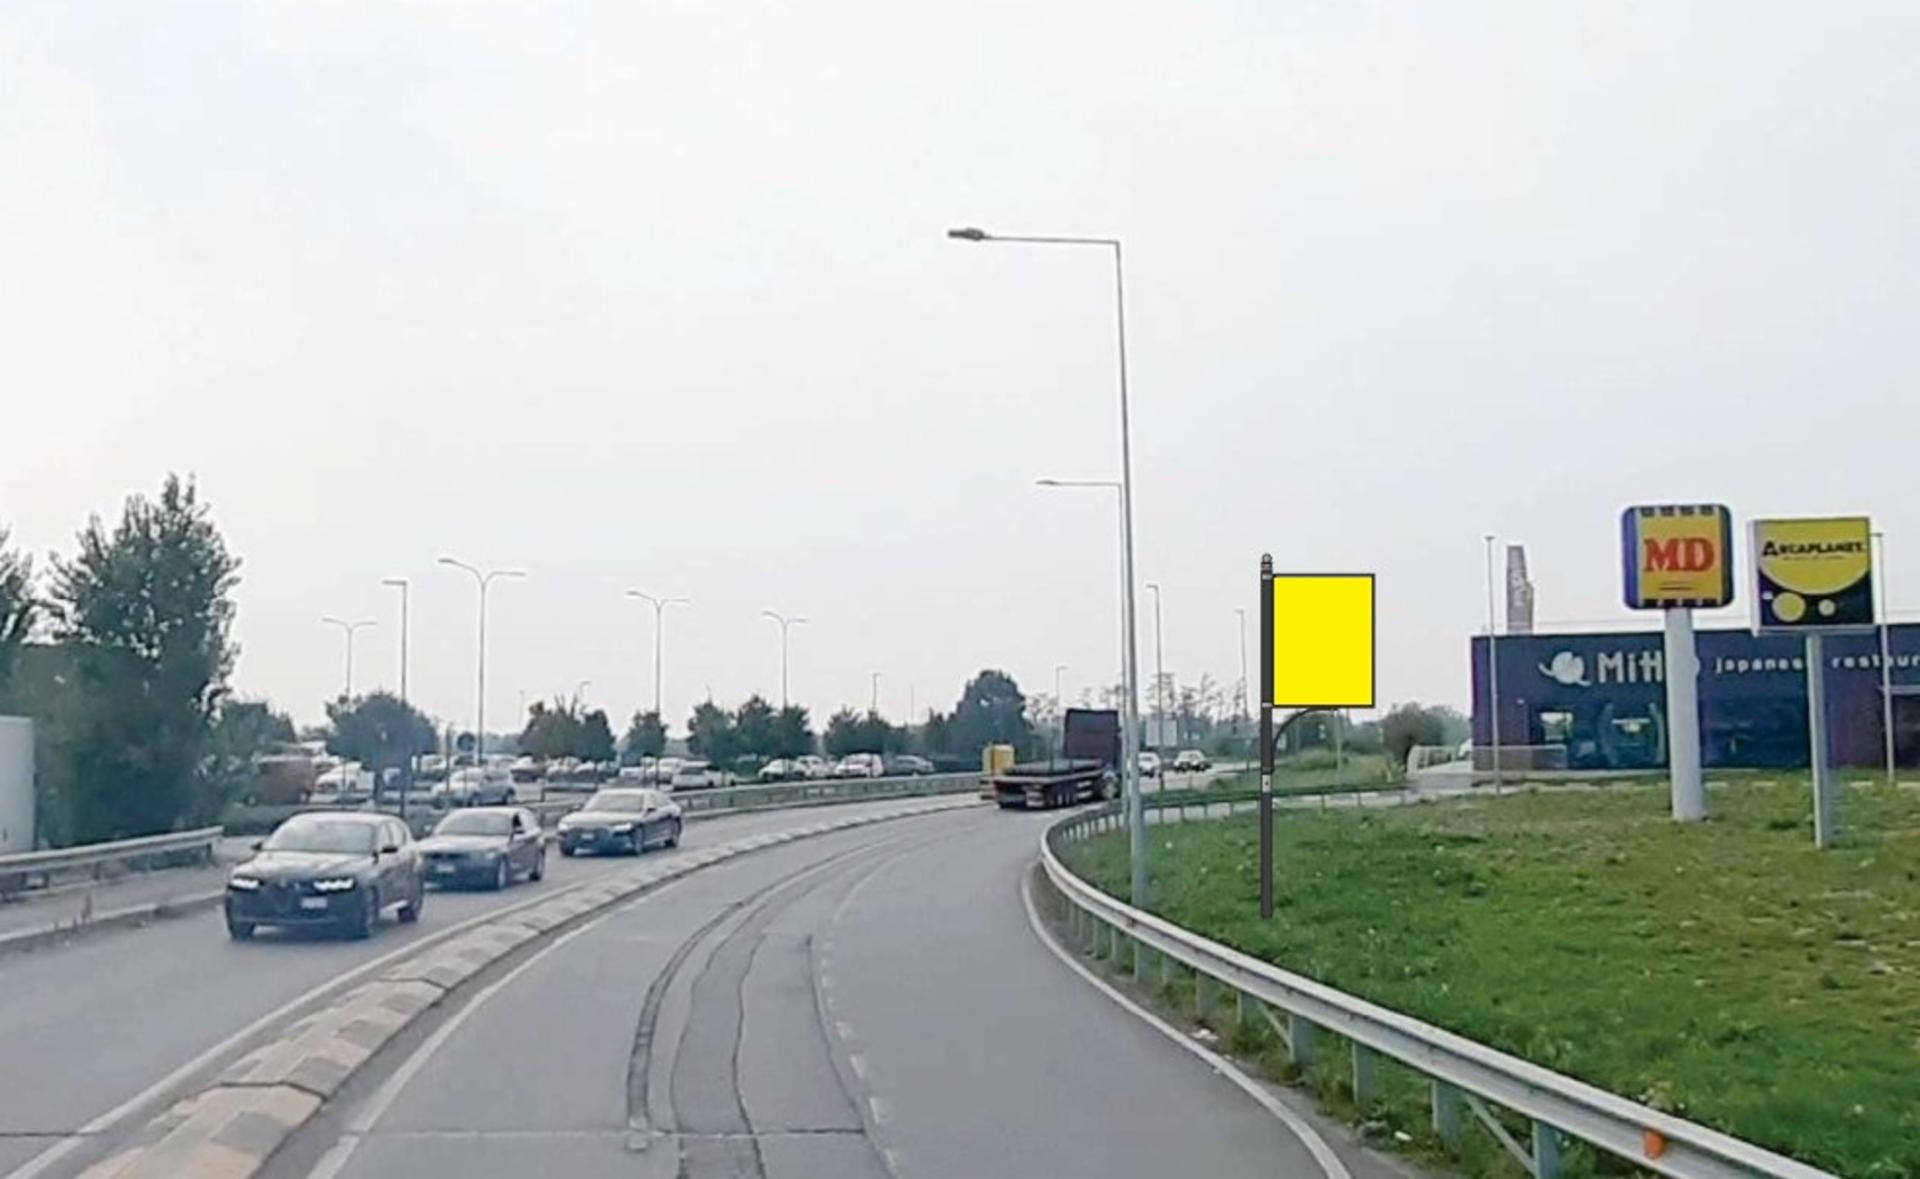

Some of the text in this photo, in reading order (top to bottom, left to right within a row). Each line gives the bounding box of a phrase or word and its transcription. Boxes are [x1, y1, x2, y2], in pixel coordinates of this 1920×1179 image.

[1641, 538, 1714, 572] MD
[1598, 650, 1700, 683] Mitt
[1715, 656, 1804, 674] japanes
